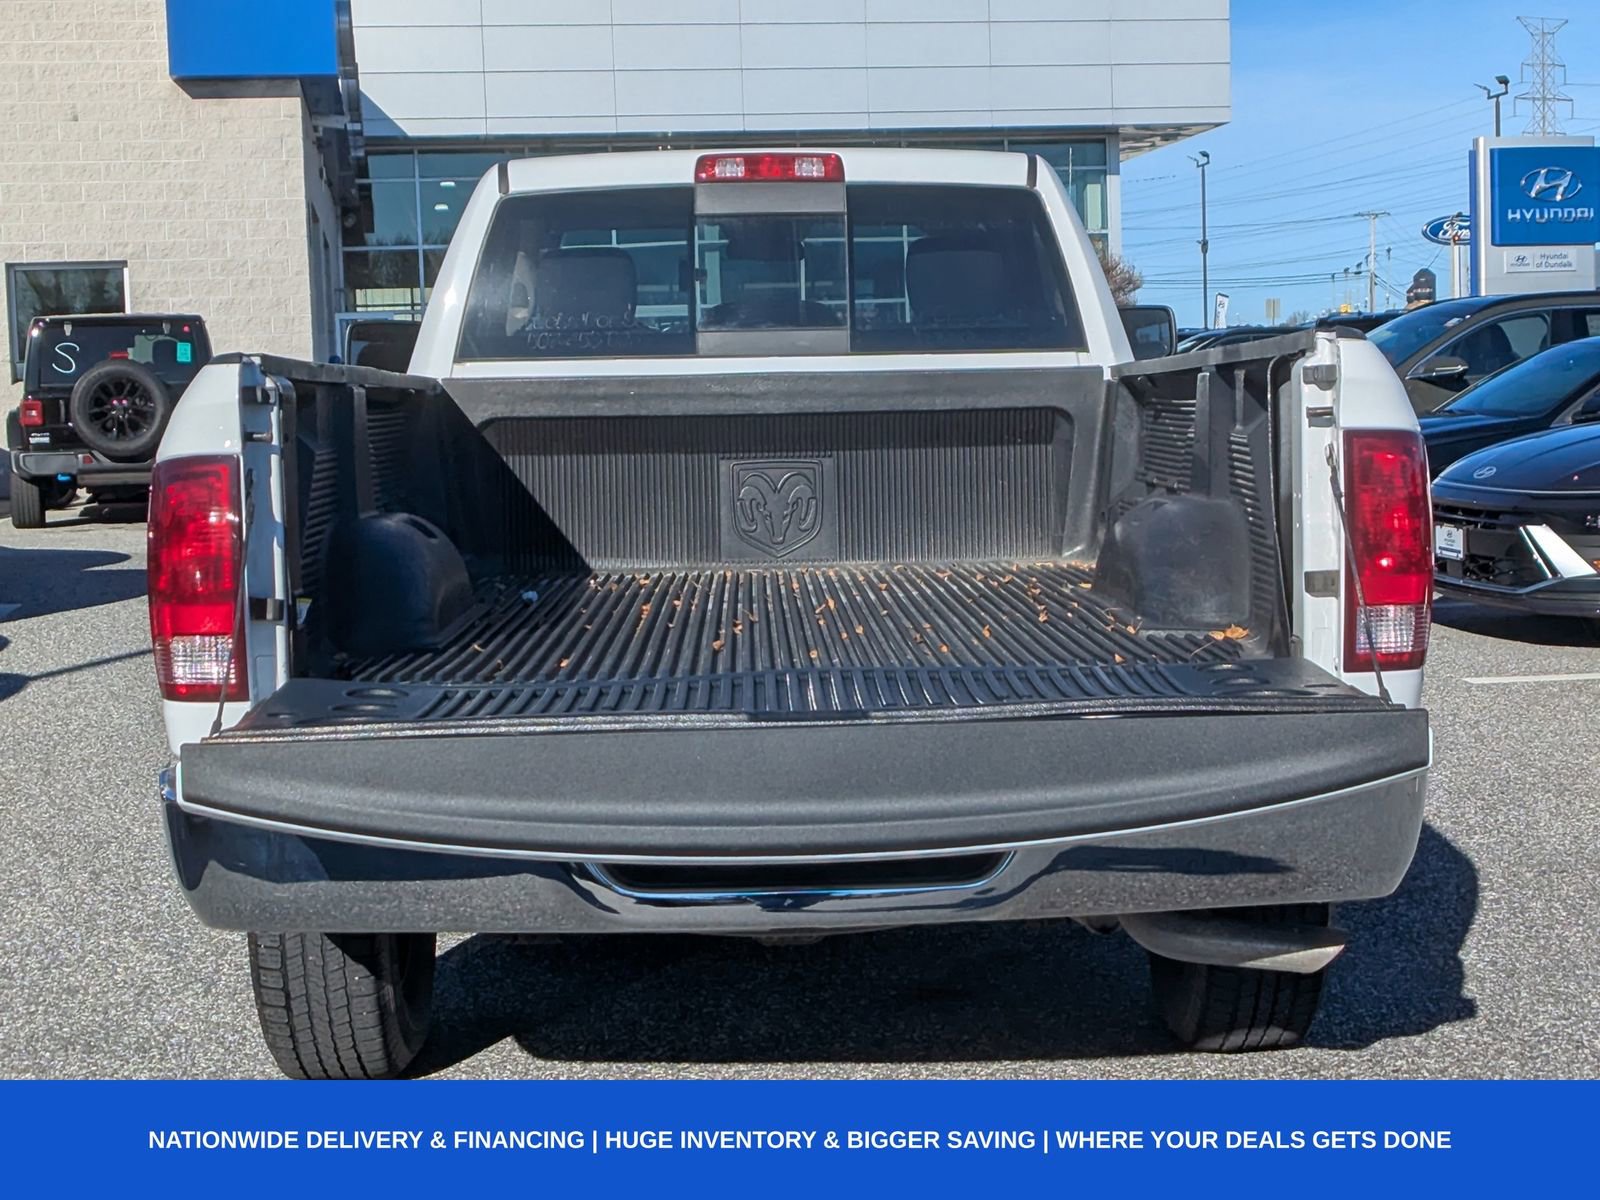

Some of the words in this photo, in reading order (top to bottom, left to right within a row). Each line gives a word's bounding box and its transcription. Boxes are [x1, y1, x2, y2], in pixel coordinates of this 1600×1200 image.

[1507, 206, 1594, 224] HYUNDAI
[1437, 220, 1471, 240] For
[1535, 260, 1544, 268] of
[1540, 252, 1569, 261] Hyundai
[51, 342, 80, 374] S
